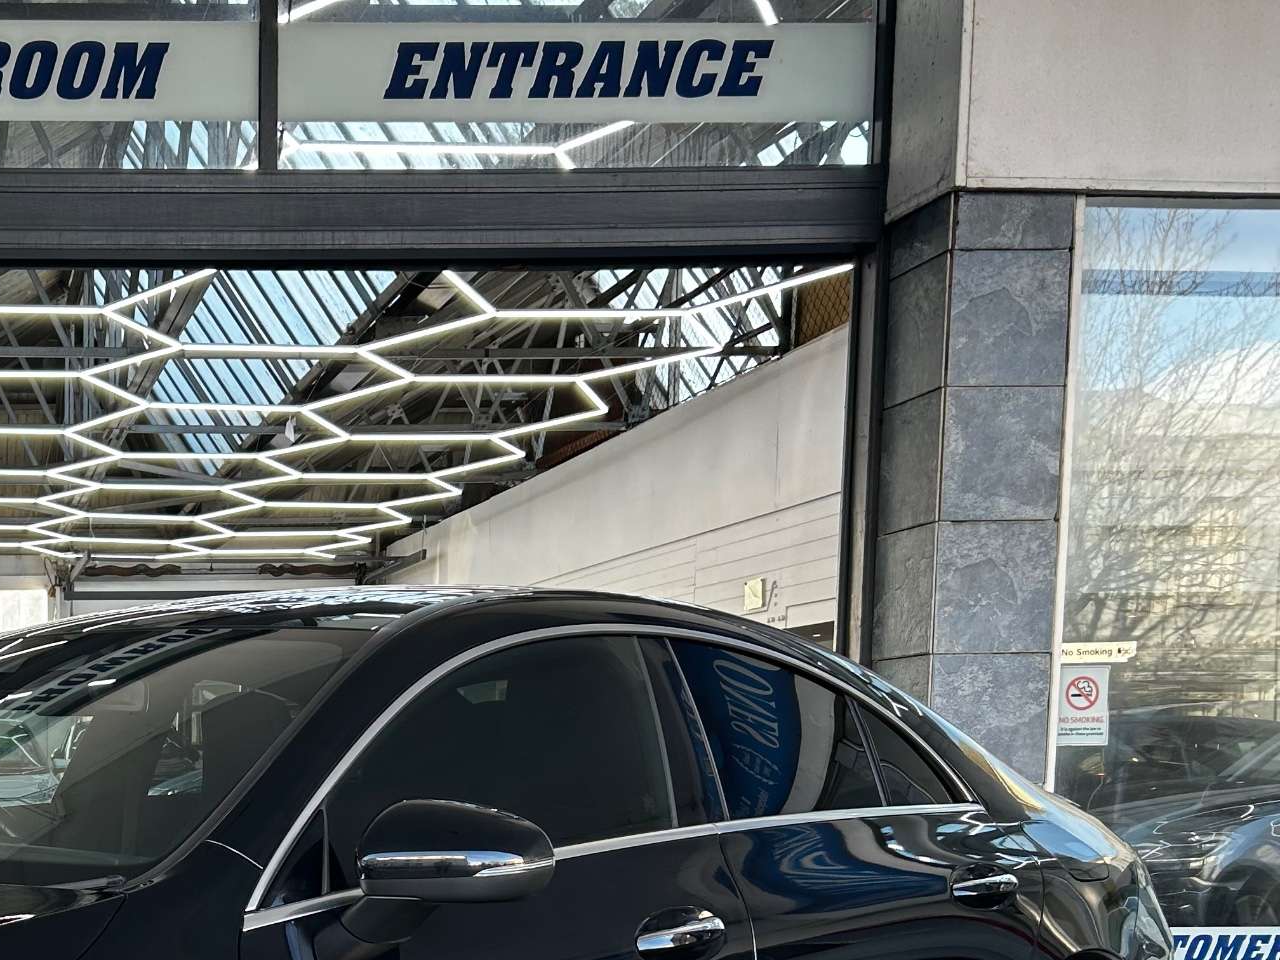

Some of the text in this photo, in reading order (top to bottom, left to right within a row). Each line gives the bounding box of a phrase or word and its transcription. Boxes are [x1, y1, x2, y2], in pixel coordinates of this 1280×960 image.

[383, 38, 775, 100] ENTRANCE
[1061, 648, 1113, 658] No Smoking
